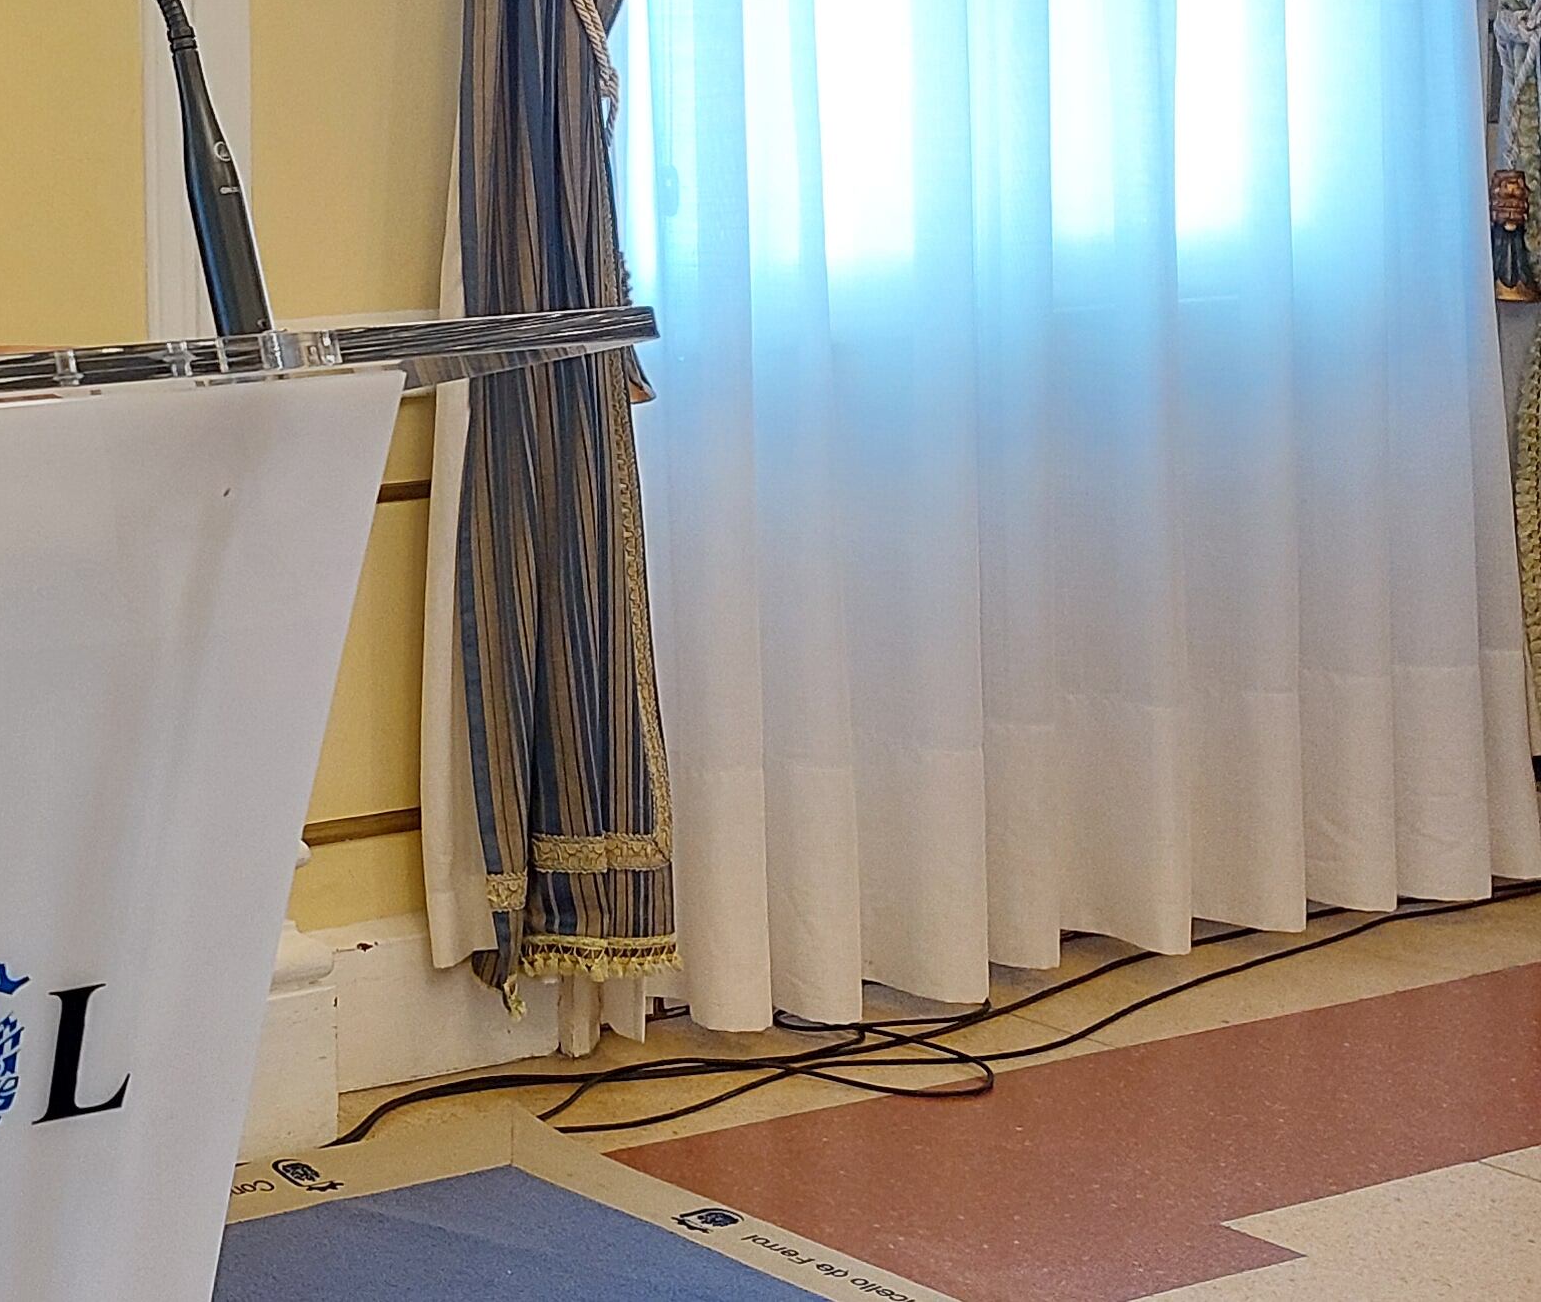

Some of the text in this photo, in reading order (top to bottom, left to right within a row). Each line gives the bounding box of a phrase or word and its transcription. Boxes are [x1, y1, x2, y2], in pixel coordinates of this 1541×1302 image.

[740, 1234, 916, 1302] cello de Ferrol
